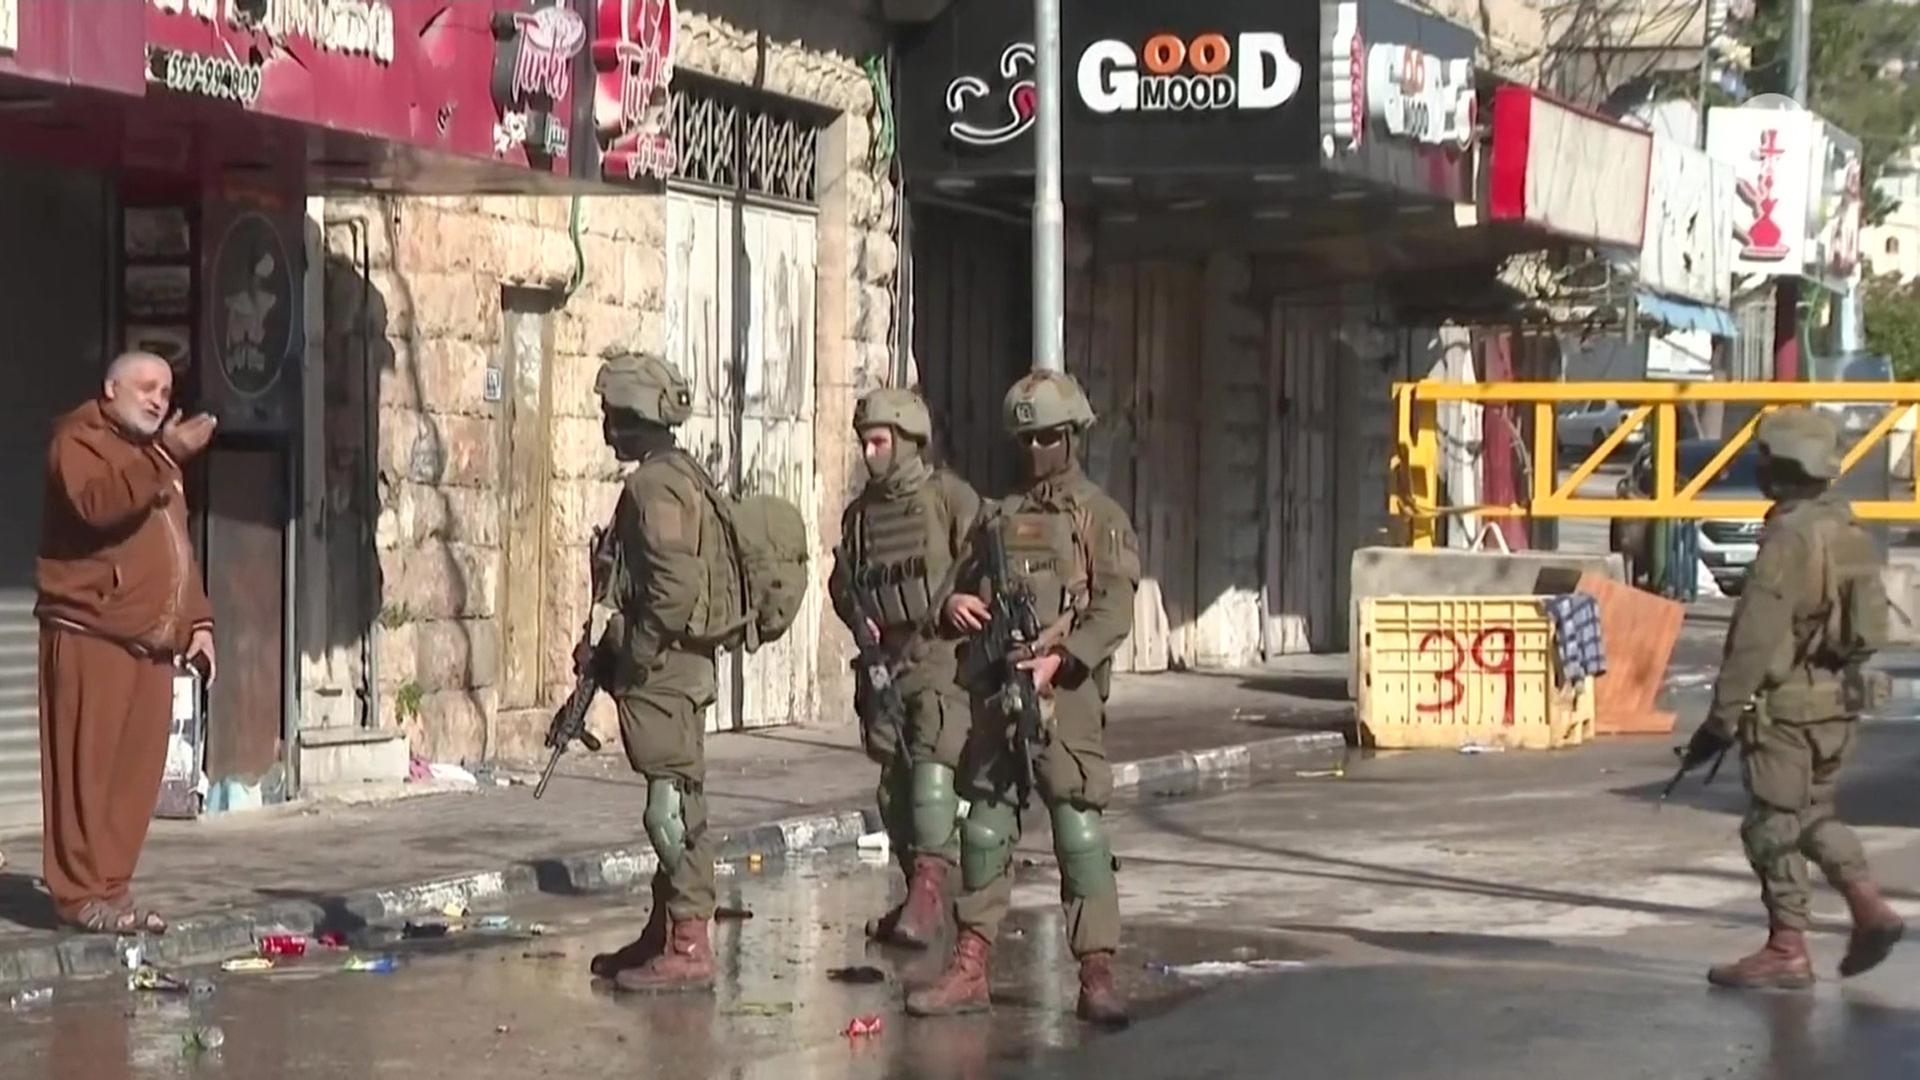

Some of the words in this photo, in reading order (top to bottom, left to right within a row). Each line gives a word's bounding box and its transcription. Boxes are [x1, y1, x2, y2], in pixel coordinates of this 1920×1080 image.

[1077, 32, 1302, 112] GOOD
[1140, 75, 1236, 110] MOOD
[1415, 627, 1516, 727] 39
